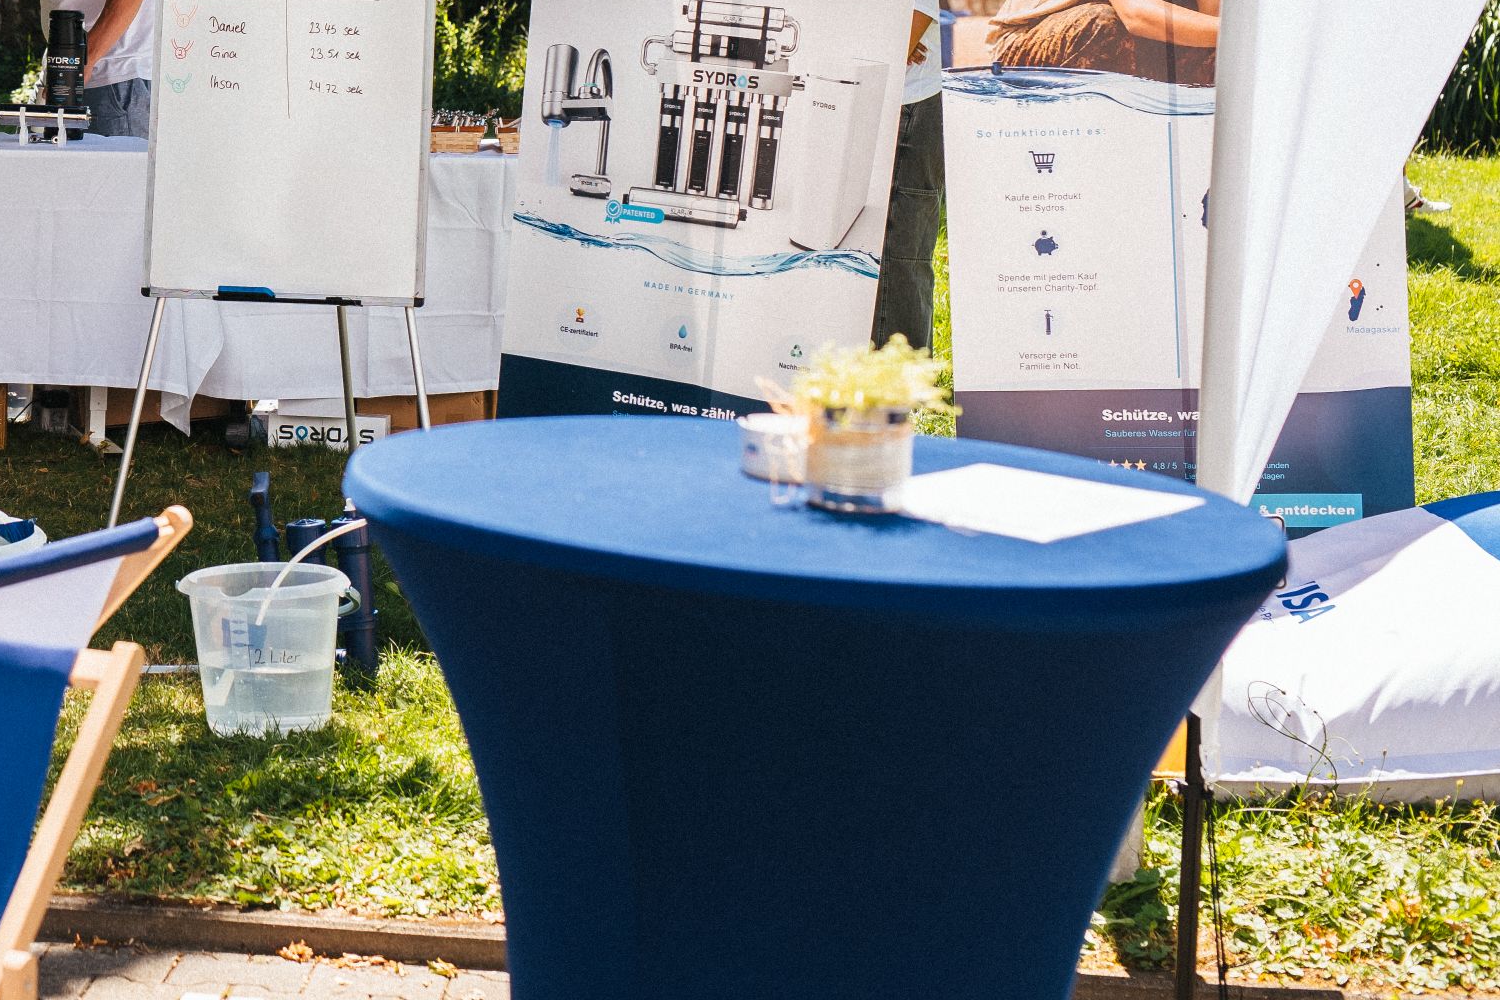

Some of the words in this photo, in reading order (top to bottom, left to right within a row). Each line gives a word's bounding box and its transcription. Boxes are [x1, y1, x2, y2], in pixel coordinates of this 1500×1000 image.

[692, 68, 760, 90] SYDROS
[975, 129, 993, 139] So
[998, 127, 1081, 138] funktioniert
[1004, 193, 1030, 202] Kaufe
[1047, 191, 1082, 201] Produkt
[622, 208, 656, 220] PATENTED
[643, 280, 670, 291] MADE
[673, 285, 684, 293] IN
[687, 286, 734, 300] GERMANY
[611, 389, 669, 414] Schütze,
[671, 402, 698, 421] was
[1101, 408, 1173, 423] Schütze,
[1275, 503, 1356, 517] entdecken
[1275, 580, 1336, 625] ISA
